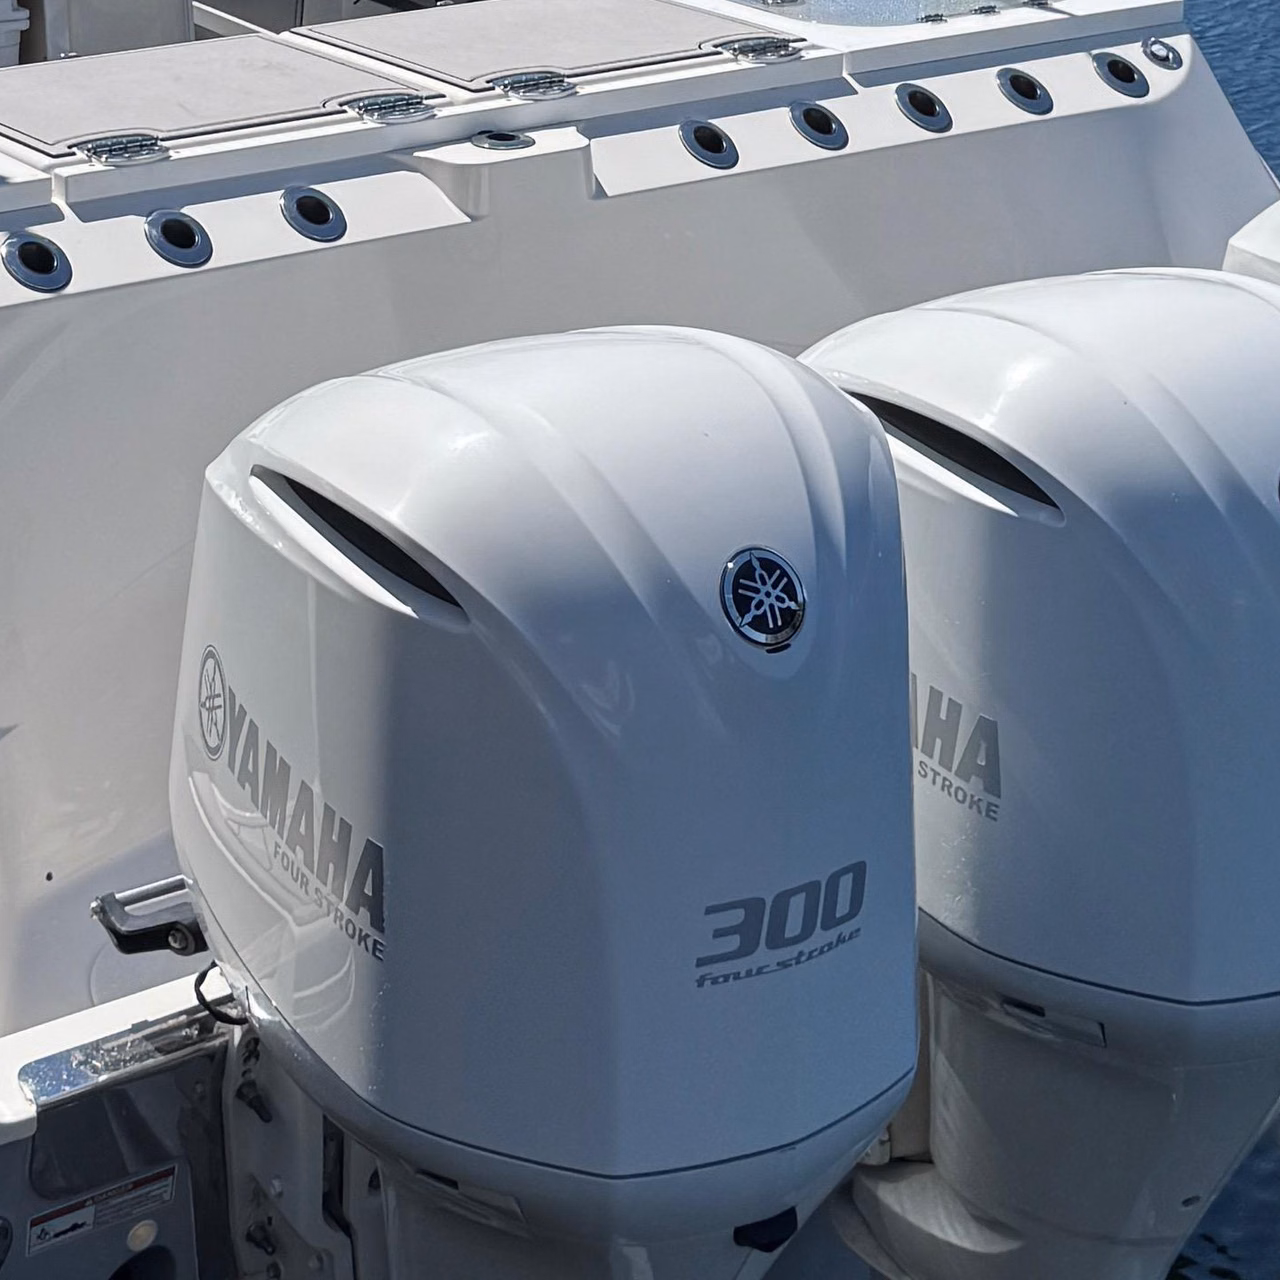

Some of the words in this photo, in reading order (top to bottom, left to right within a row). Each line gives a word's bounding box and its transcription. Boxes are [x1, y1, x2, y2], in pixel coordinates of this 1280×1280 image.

[911, 671, 1001, 800] HA
[918, 759, 1001, 822] STROKE
[228, 684, 384, 934] YAMAHA
[273, 840, 309, 896] FOUR
[312, 886, 385, 962] STROKE
[695, 860, 867, 968] 300
